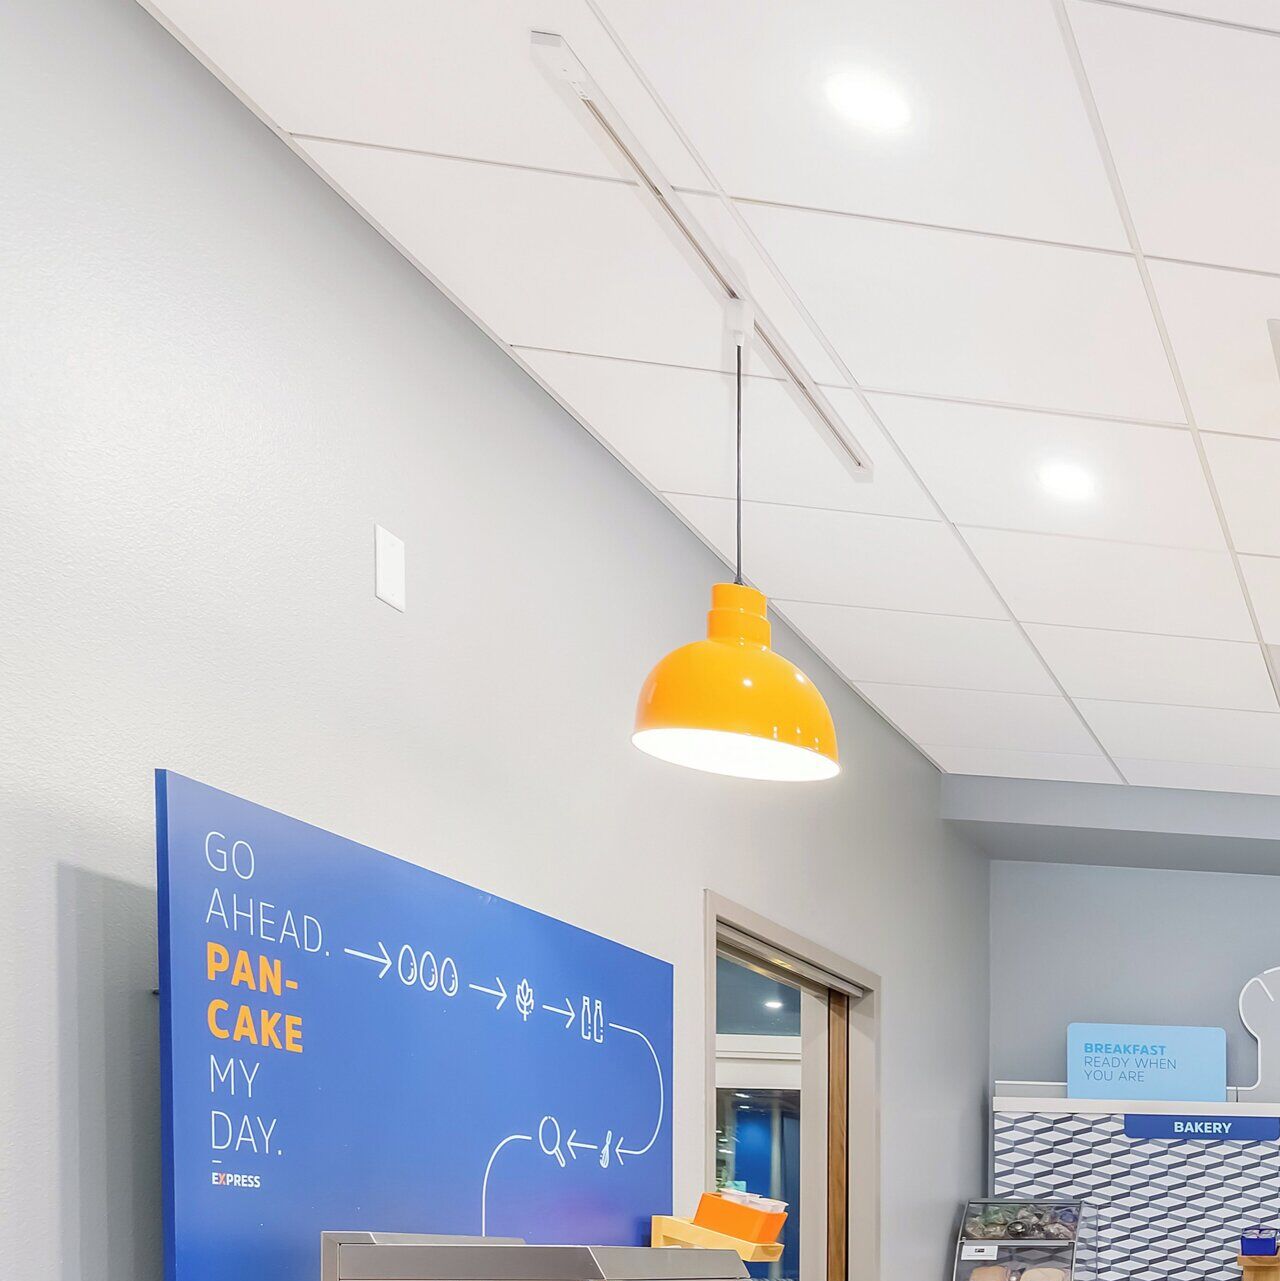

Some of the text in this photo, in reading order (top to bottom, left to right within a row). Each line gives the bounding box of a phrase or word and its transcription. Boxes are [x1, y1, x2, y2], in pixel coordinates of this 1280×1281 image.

[205, 831, 255, 880] GO
[206, 887, 330, 957] AHEAD.
[206, 941, 299, 997] PAN-
[207, 998, 304, 1054] CAKE
[1084, 1042, 1167, 1056] BREAKFAST
[1084, 1056, 1177, 1070] READY WHEN
[210, 1054, 260, 1098] MY
[1084, 1069, 1145, 1082] YOU ARE
[211, 1110, 282, 1155] DAY.
[1173, 1121, 1232, 1134] BAKERY
[211, 1171, 261, 1188] EXPRESS
